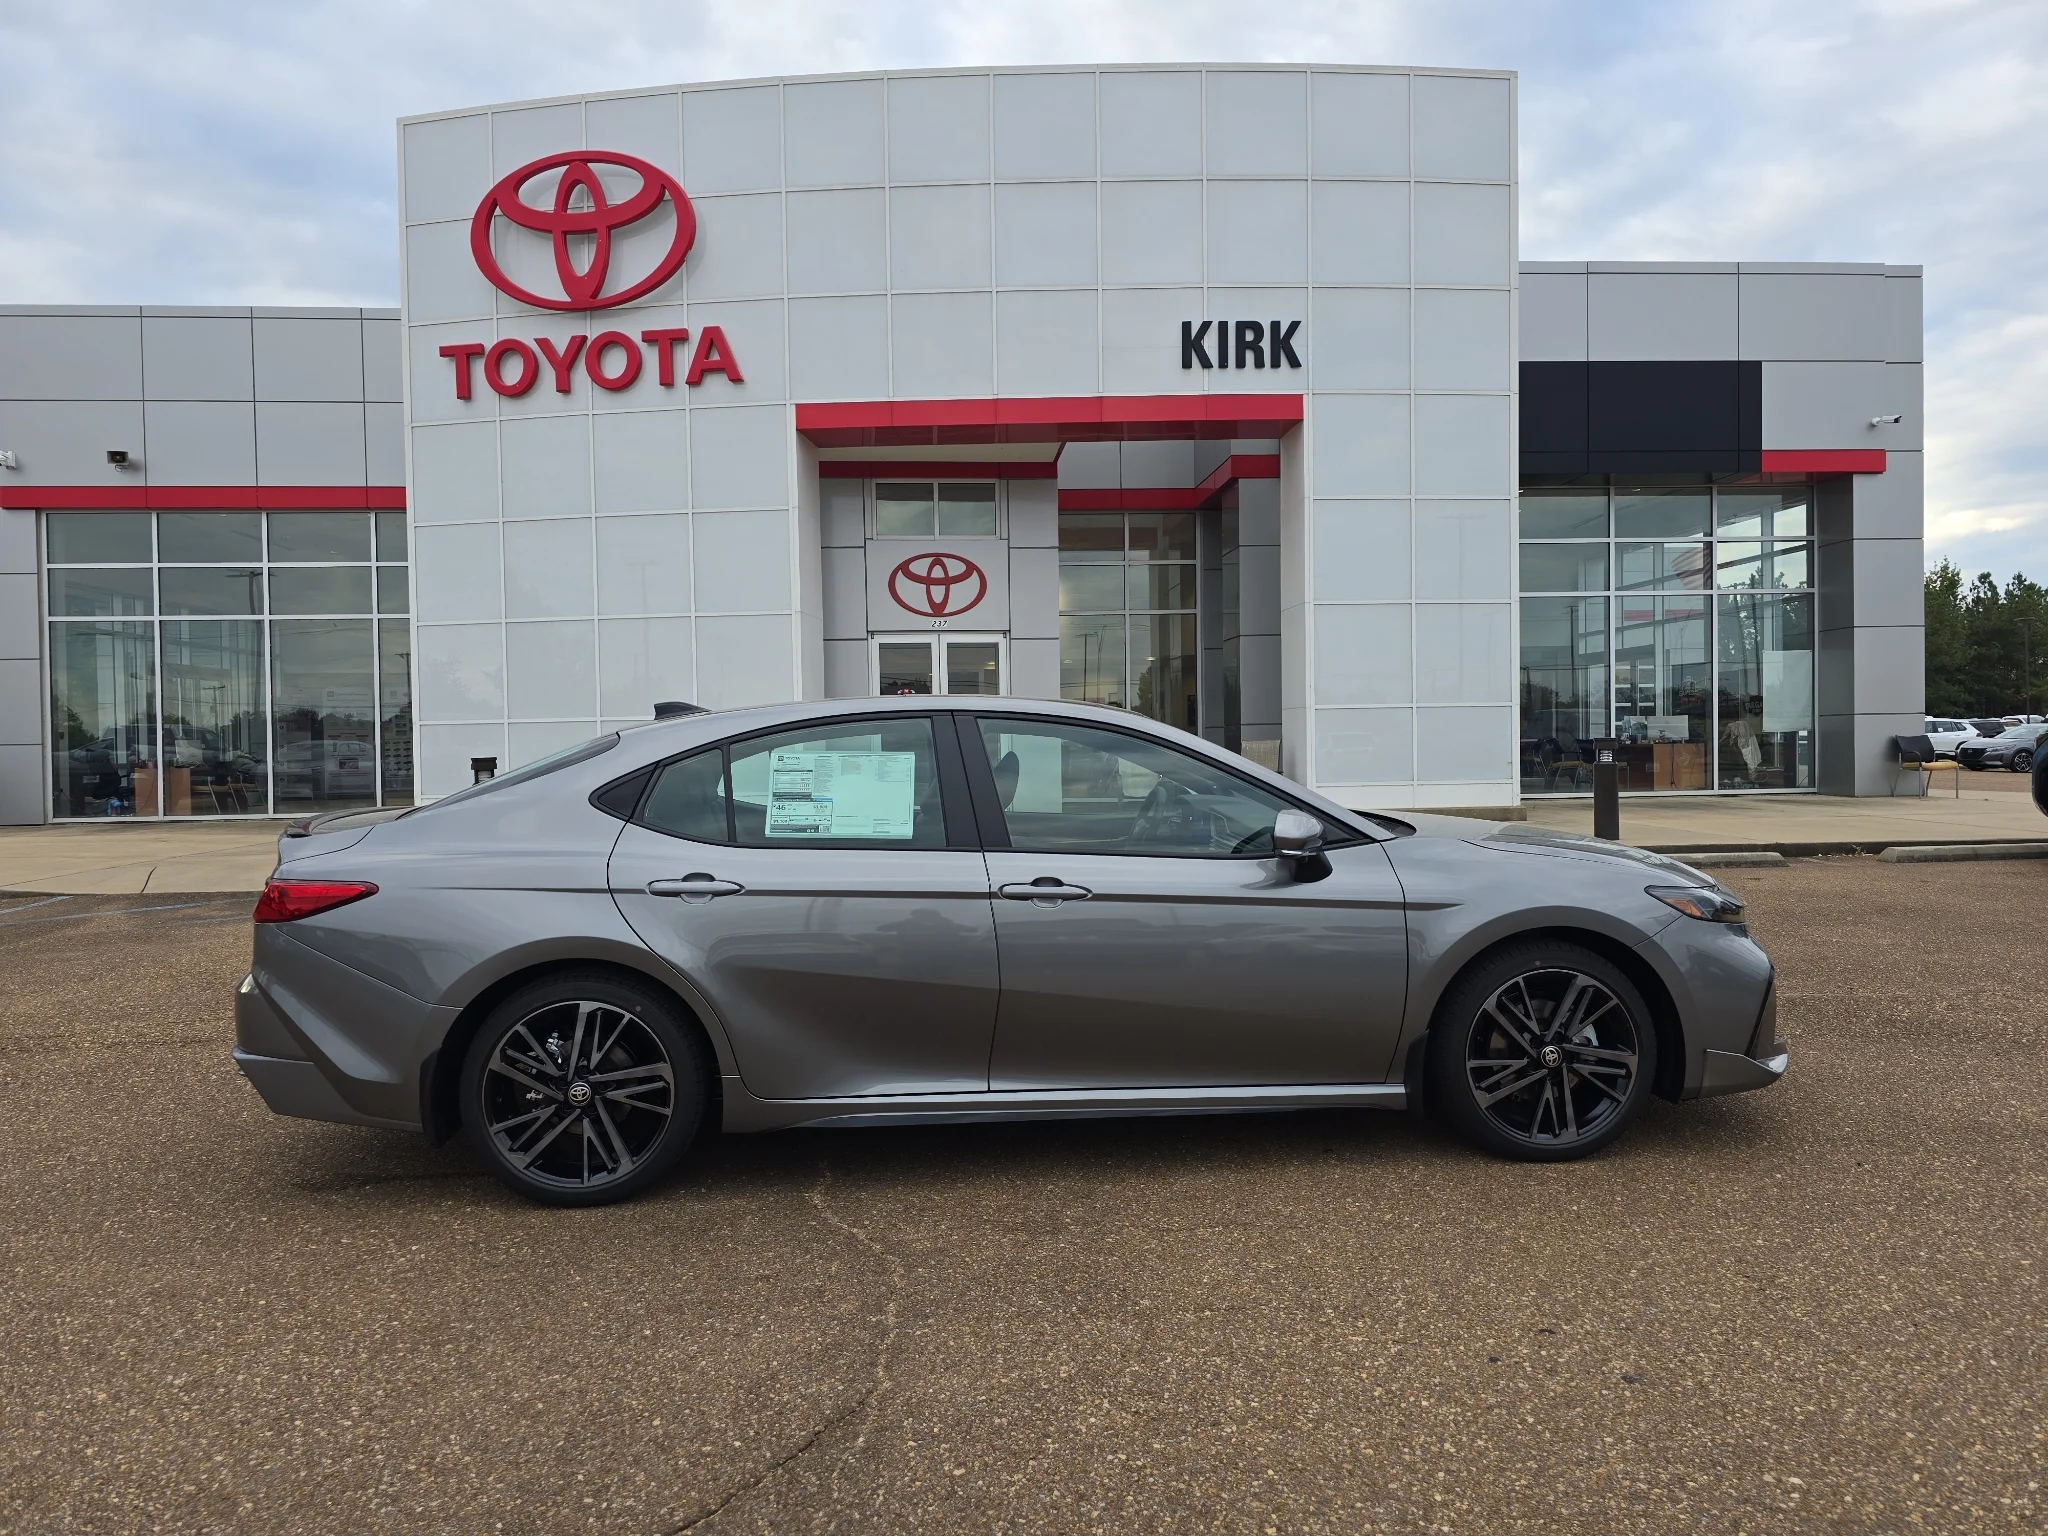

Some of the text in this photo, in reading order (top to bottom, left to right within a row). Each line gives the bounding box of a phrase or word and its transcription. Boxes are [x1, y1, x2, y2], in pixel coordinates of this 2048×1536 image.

[439, 325, 744, 401] TOYOTA
[1181, 321, 1303, 369] KIRK
[931, 620, 948, 628] 237
